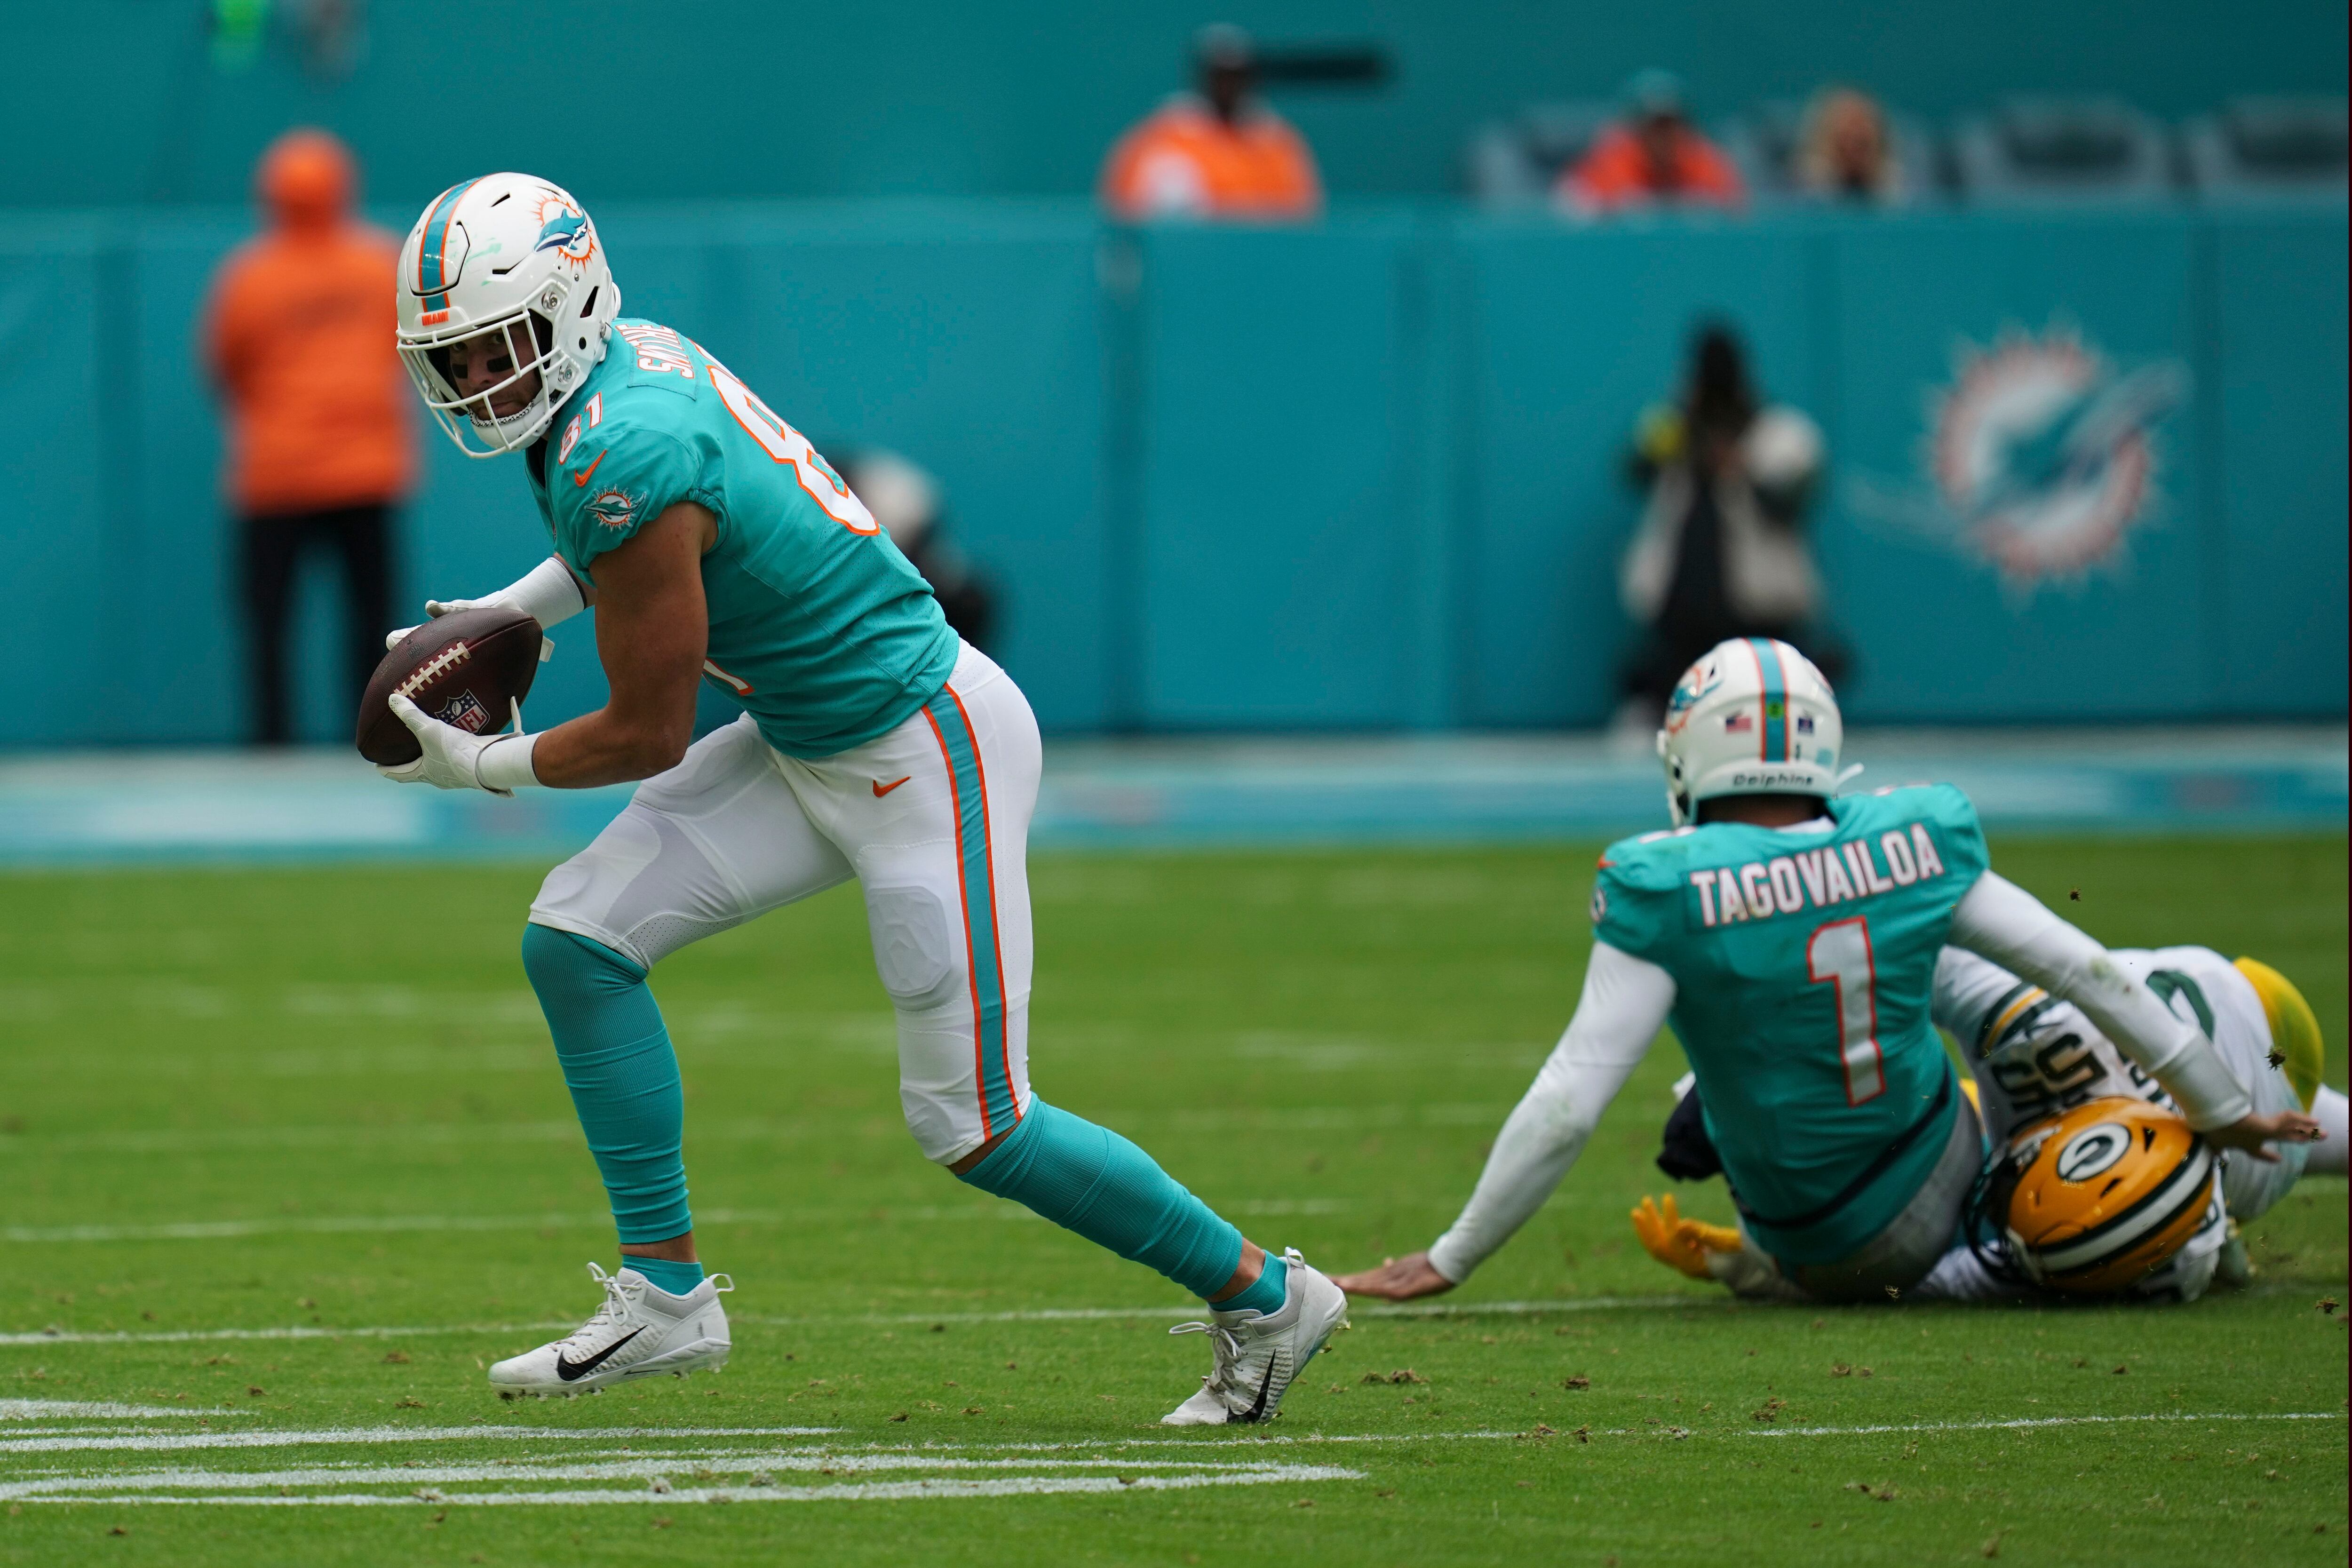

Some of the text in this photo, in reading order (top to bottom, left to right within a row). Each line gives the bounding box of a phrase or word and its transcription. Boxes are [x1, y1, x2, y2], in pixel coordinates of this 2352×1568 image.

[559, 391, 602, 465] 81
[1690, 822, 1945, 927] TAGOVAILOA
[1806, 915, 1886, 1107] 1
